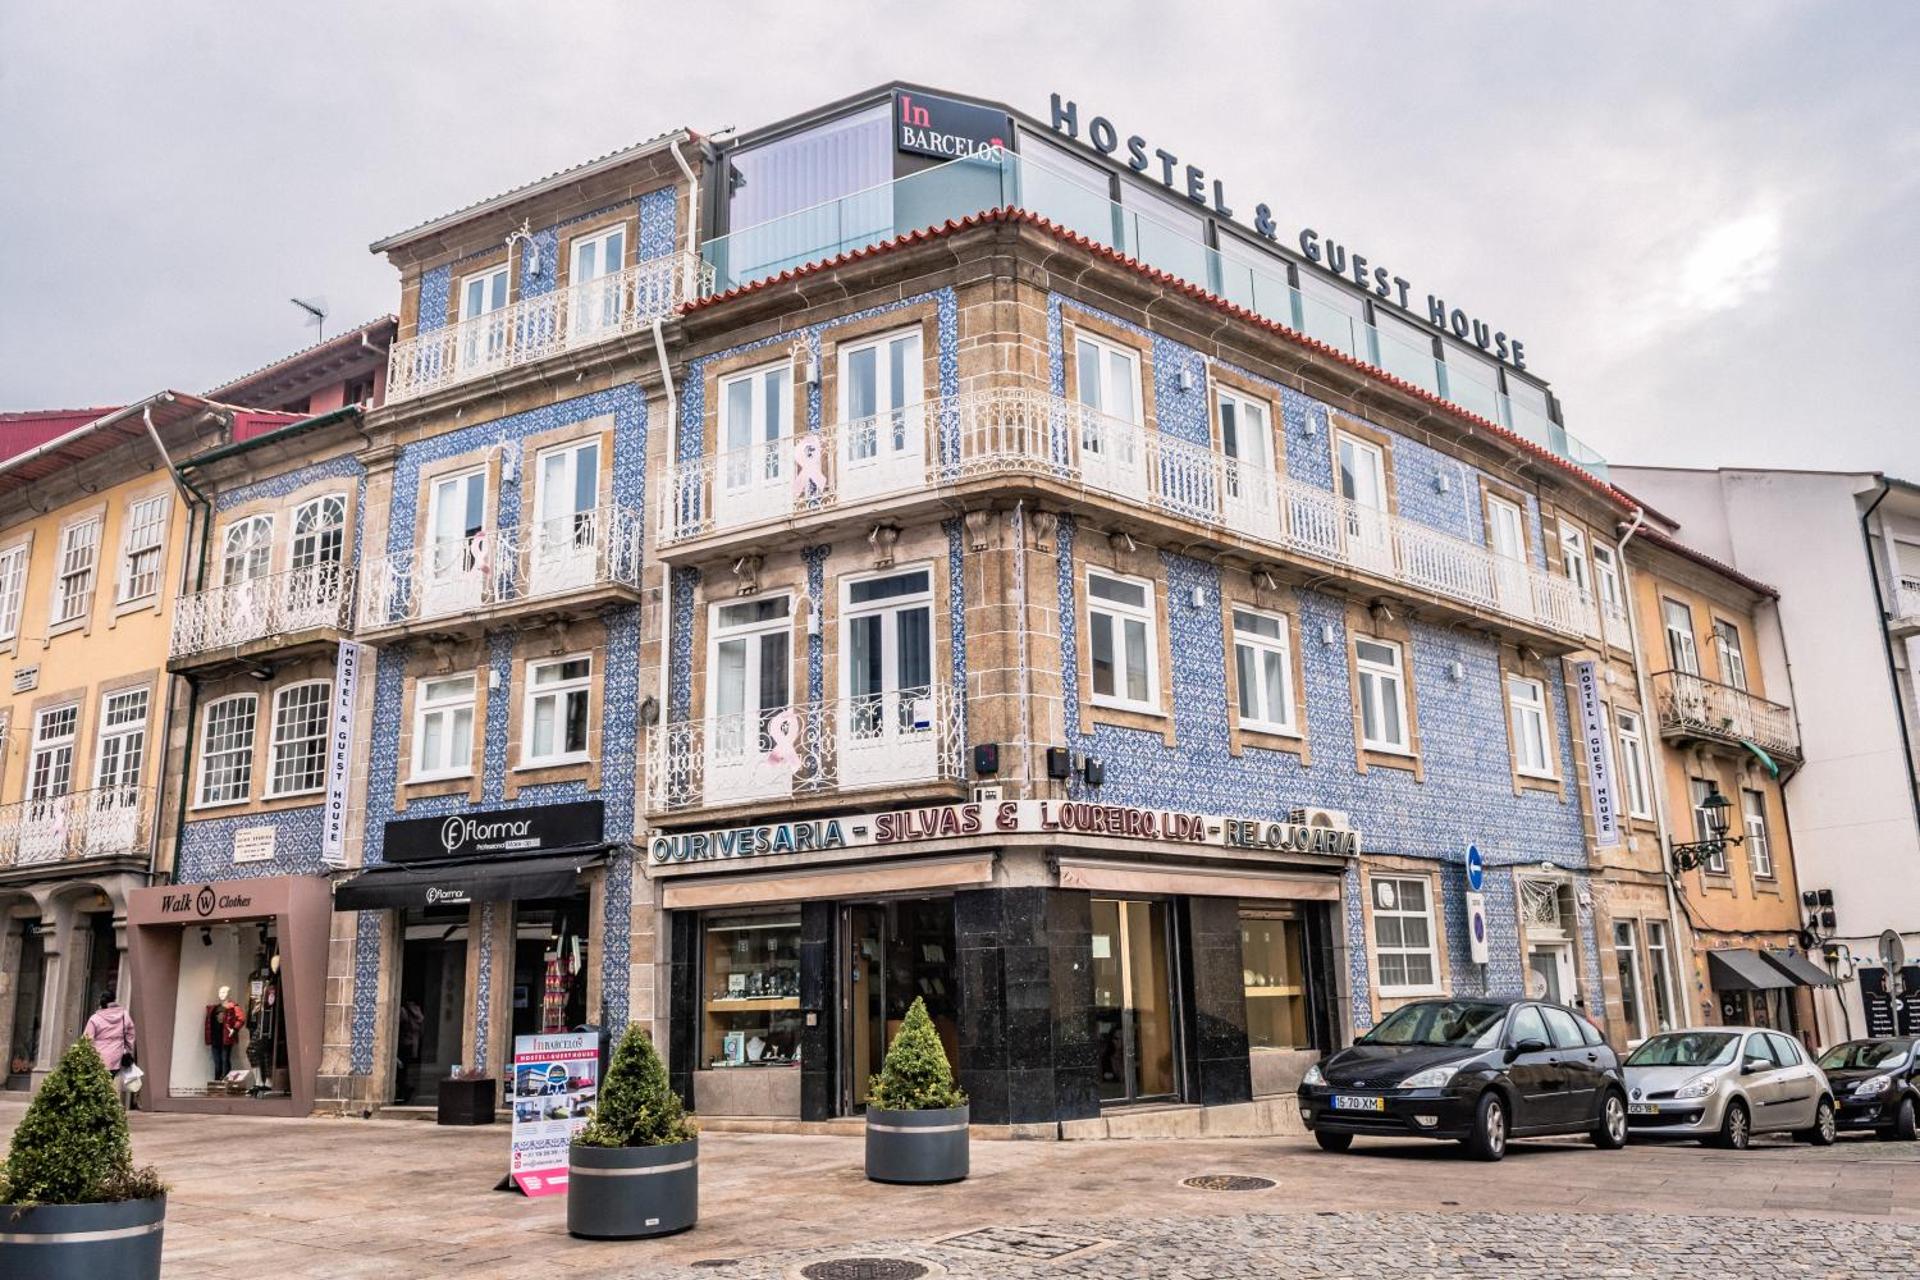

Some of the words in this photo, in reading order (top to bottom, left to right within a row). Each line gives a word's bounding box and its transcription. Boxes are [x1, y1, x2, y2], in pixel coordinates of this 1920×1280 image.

[901, 96, 931, 127] In
[903, 126, 1004, 163] BARCELOS
[1050, 92, 1232, 217] HOSTEL
[1255, 203, 1277, 240] &
[1299, 228, 1410, 309] GUEST
[1427, 294, 1526, 370] HOUSE
[341, 648, 354, 706] HOSTEL
[339, 714, 347, 724] &
[336, 731, 347, 781] GUEST
[1581, 667, 1595, 717] HOSTEL
[1591, 737, 1603, 779] GUEST
[1598, 787, 1611, 832] HOUSE
[330, 789, 342, 842] HOUSE
[466, 820, 532, 841] flormar
[652, 819, 847, 862] OURIVESARIA
[875, 804, 982, 842] SILVAS
[1223, 818, 1358, 855] RELOJOARIA
[162, 894, 192, 913] Walk
[200, 896, 211, 910] W
[218, 895, 252, 909] Clothes
